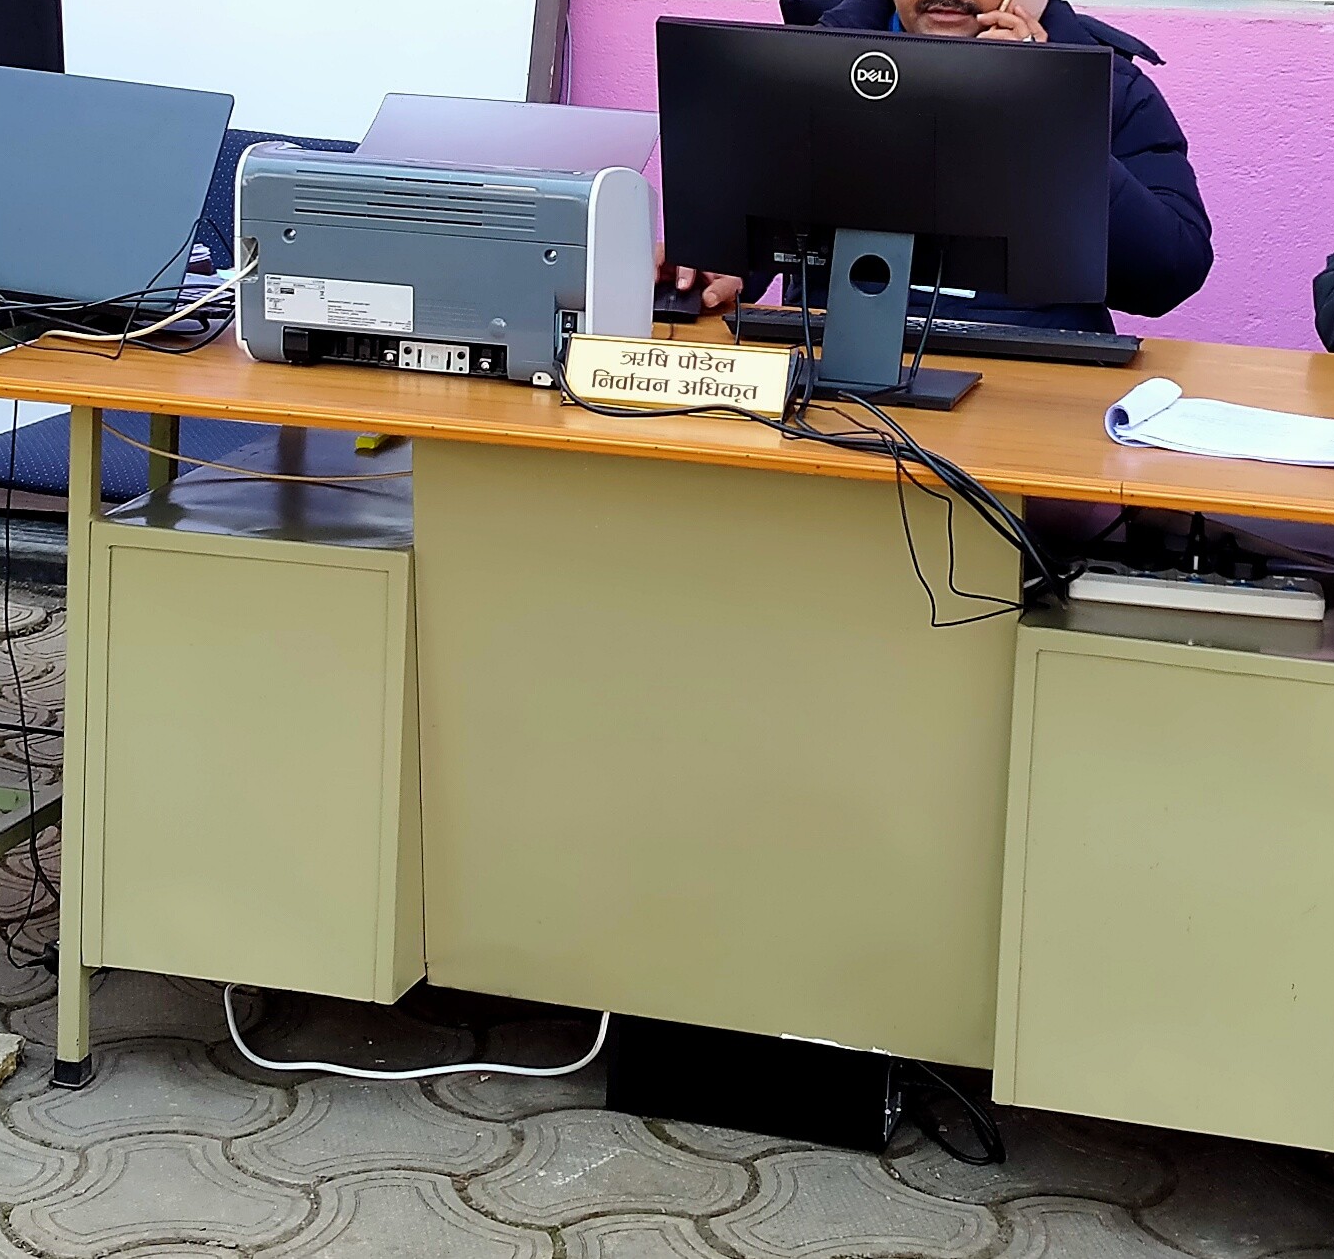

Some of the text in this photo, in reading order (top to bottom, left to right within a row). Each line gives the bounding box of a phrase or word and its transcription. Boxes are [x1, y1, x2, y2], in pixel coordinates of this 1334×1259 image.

[857, 68, 894, 84] DELL
[620, 348, 737, 374] ऋषि पौडेल
[591, 369, 759, 404] निर्वाचन अधिकृत
